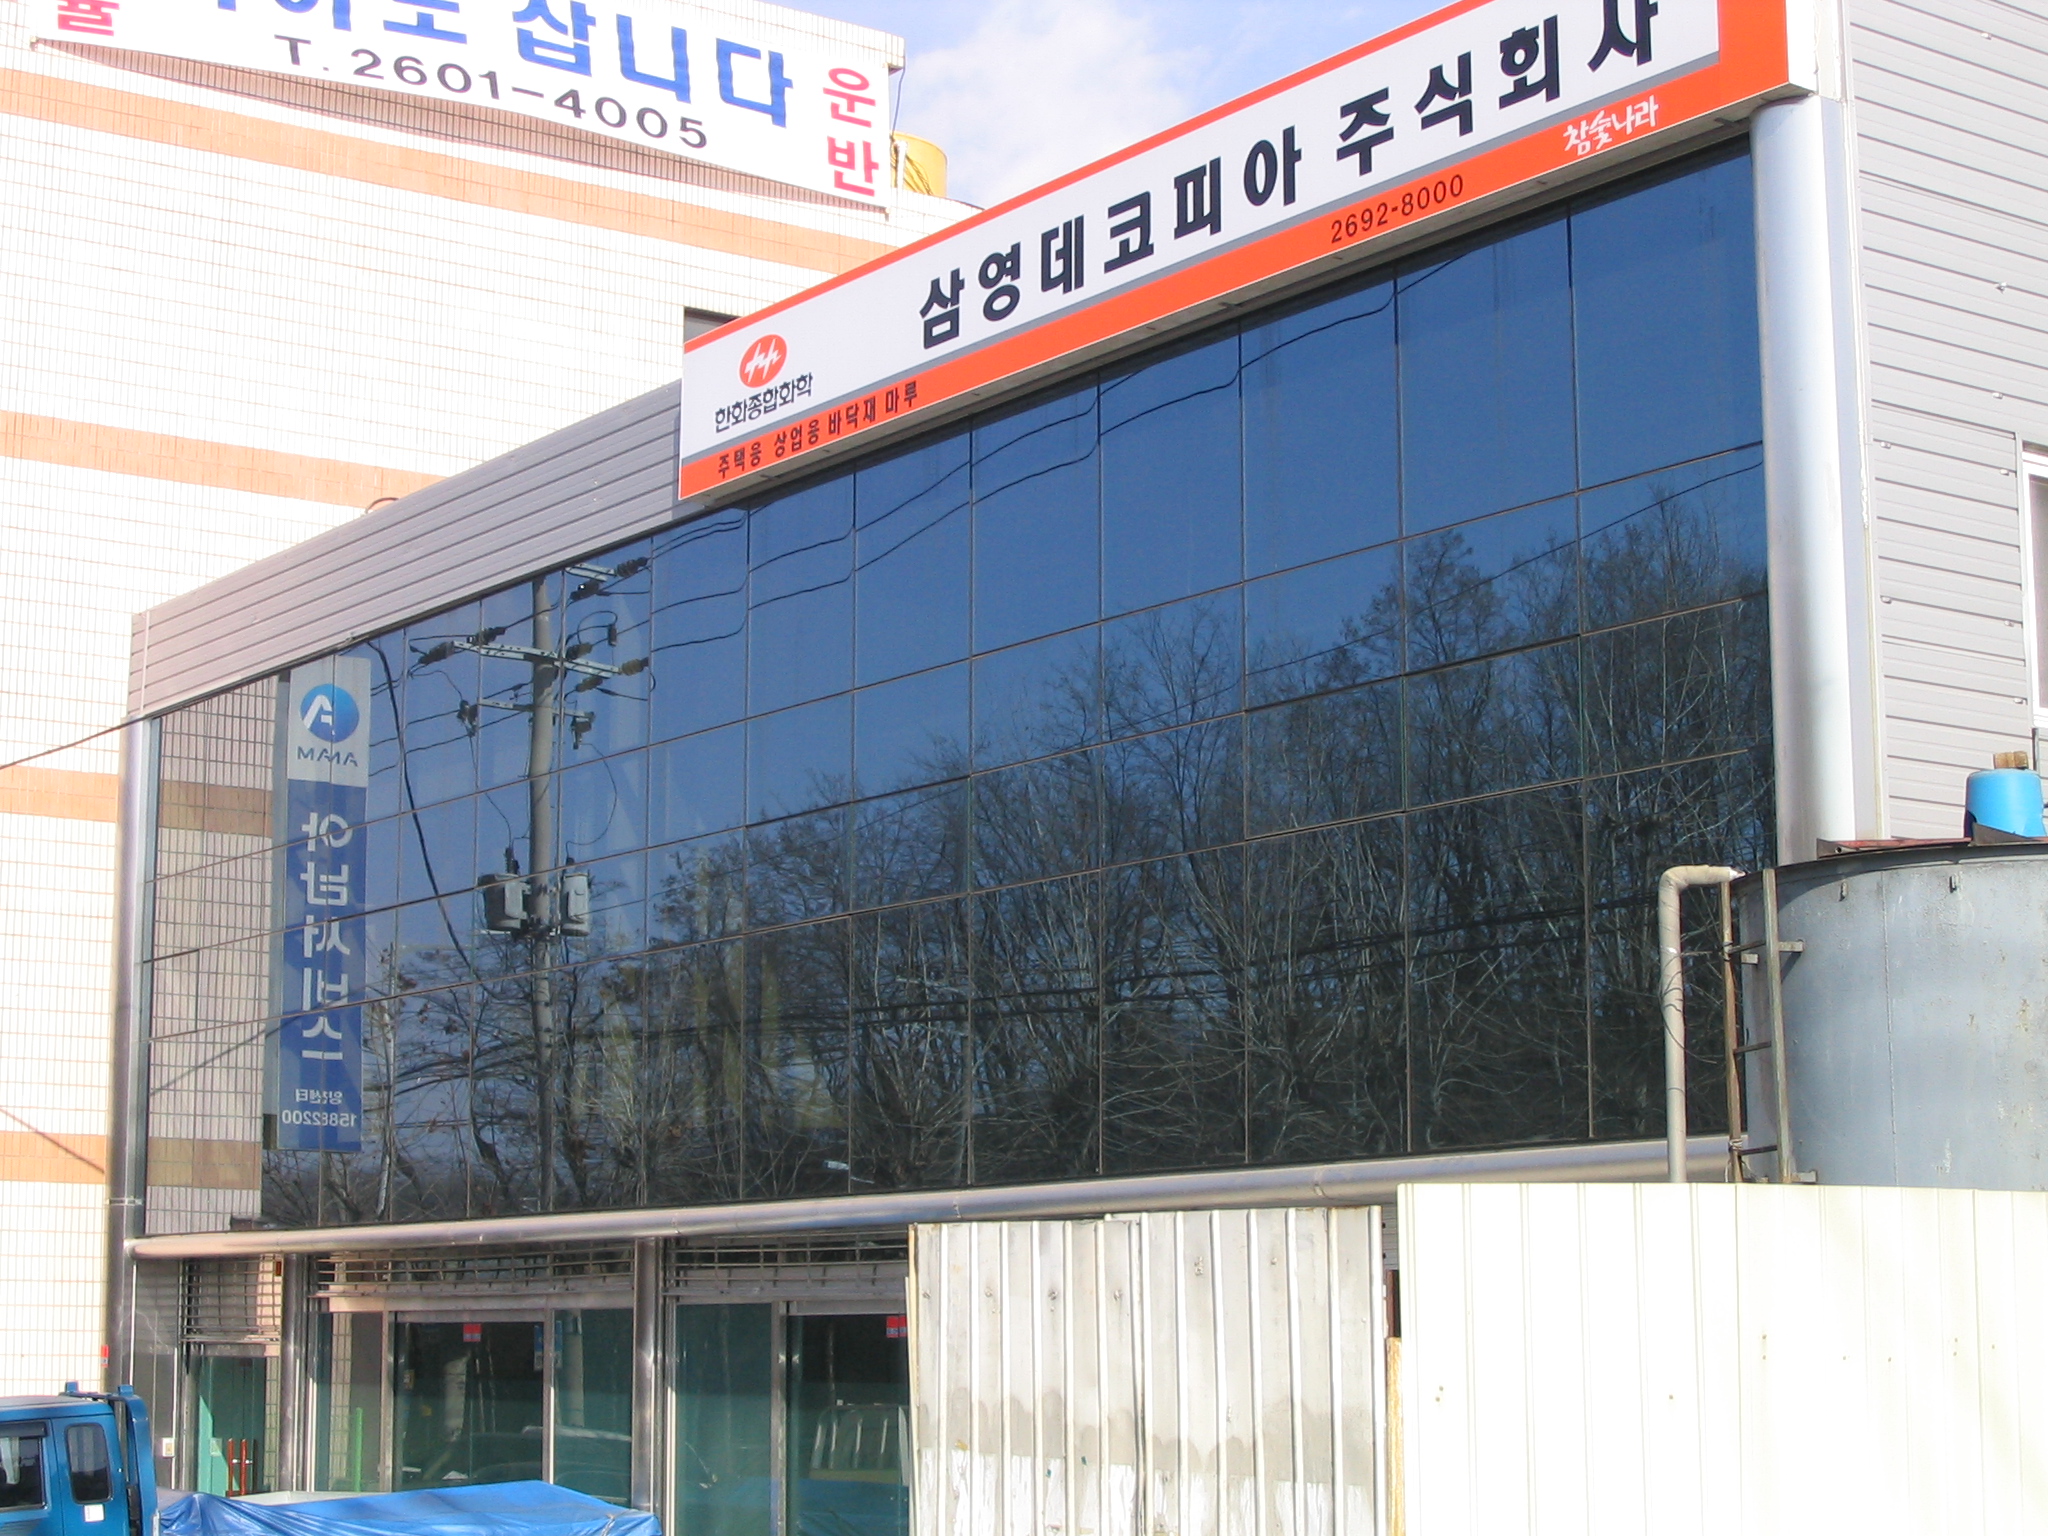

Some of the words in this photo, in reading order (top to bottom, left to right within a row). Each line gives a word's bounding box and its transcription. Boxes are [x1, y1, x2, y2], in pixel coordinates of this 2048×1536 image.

[822, 67, 880, 197] 운반
[1563, 95, 1659, 157] 참숯나라
[919, 125, 1302, 350] 삼영데코피아
[1336, 0, 1658, 177] 주식회사
[1331, 174, 1464, 244] 2692-8000
[714, 372, 813, 433] 한화종합화학
[828, 395, 876, 435] 바닥재
